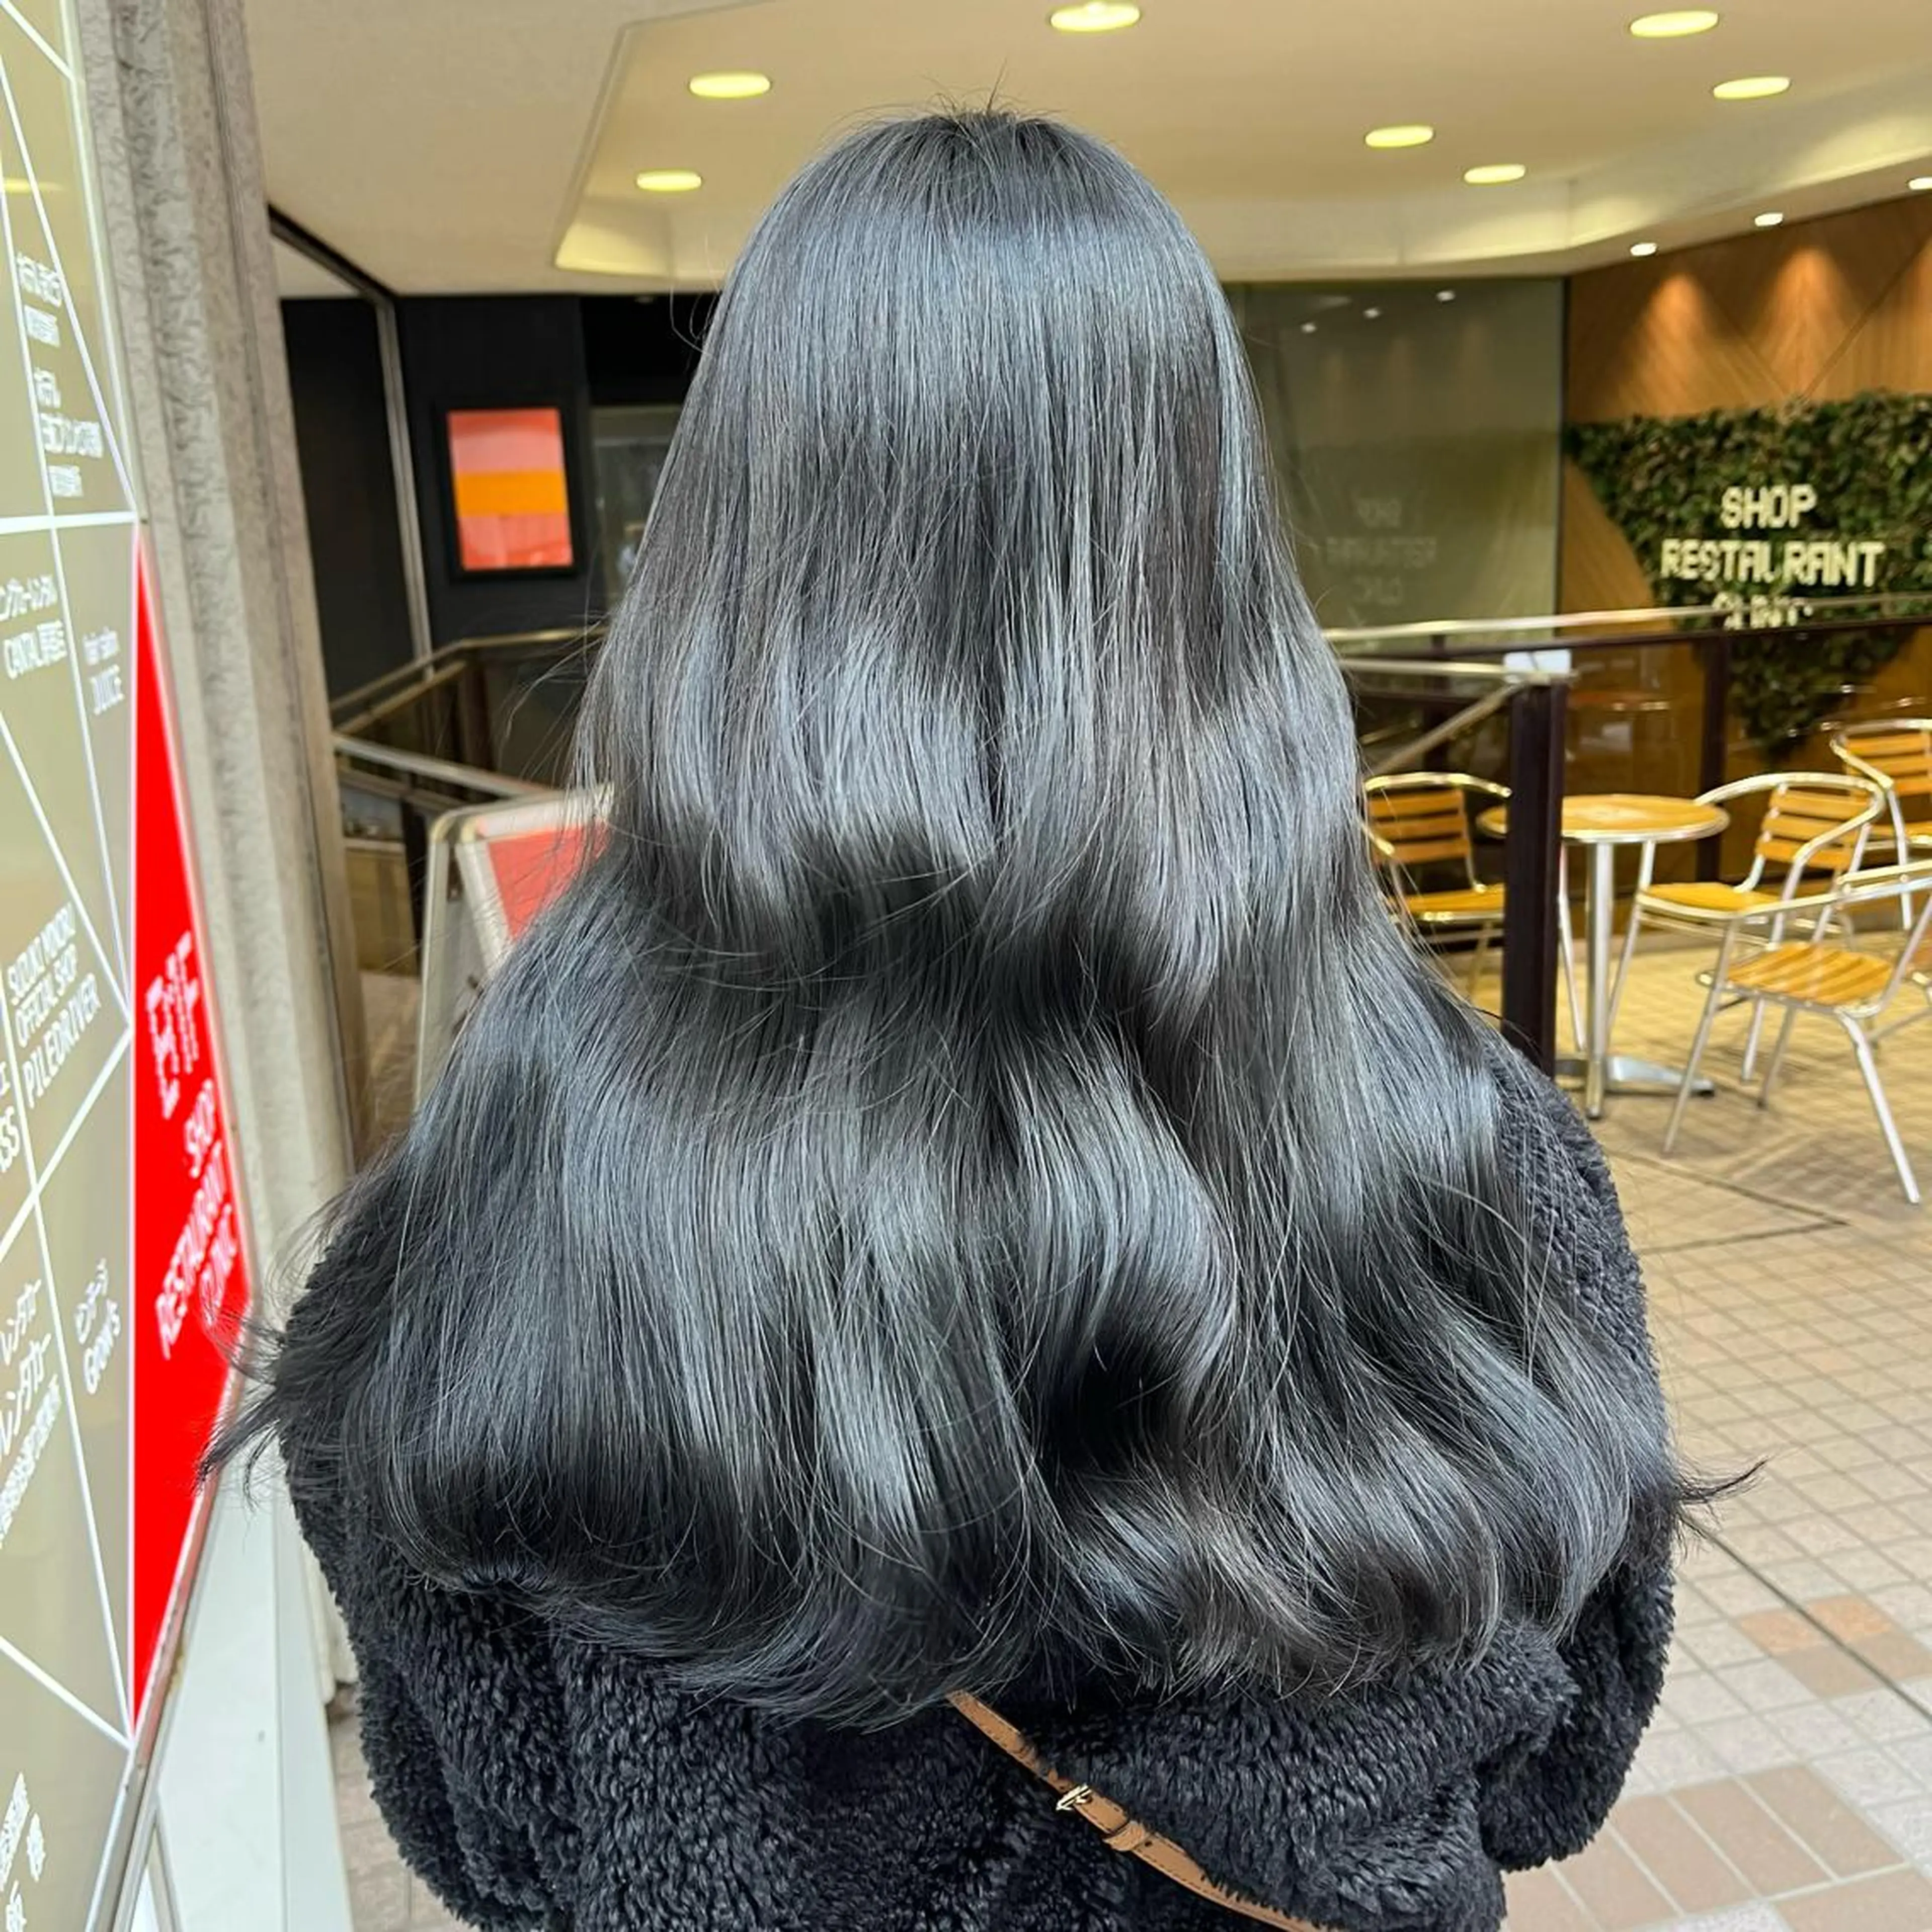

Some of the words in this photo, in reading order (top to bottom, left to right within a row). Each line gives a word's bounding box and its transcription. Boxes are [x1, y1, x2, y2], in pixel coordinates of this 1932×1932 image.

[1721, 484, 1817, 529] SHOP
[1661, 538, 1886, 587] RESTAURANT
[22, 972, 102, 1109] PILEDRIVER
